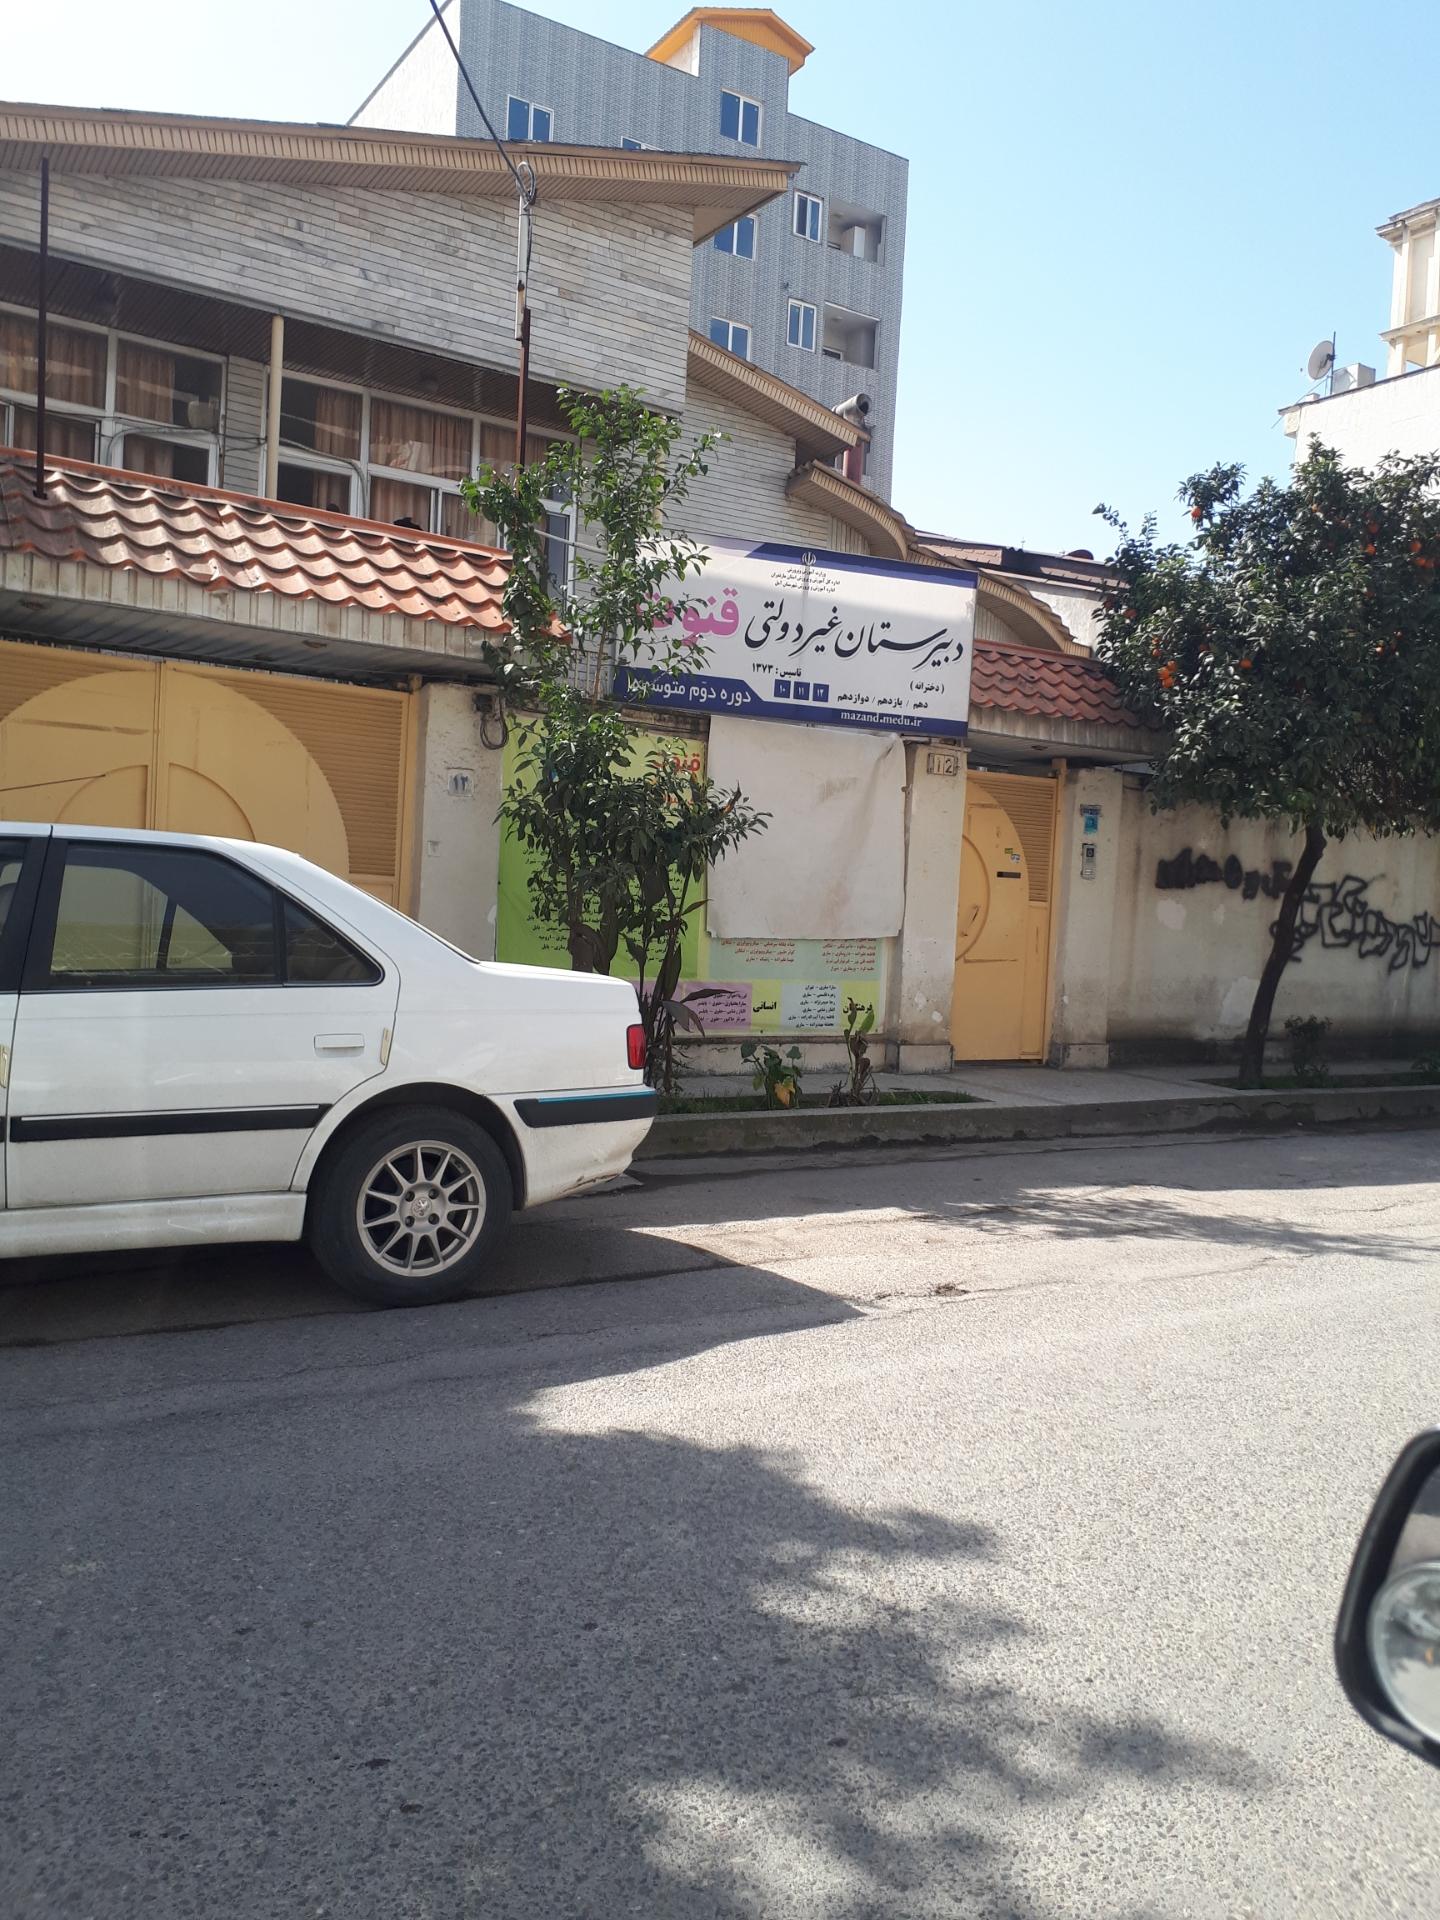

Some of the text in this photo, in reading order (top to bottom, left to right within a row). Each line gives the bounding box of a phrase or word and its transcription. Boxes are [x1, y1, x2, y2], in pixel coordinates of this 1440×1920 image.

[834, 611, 964, 670] دبیرستان
[720, 688, 752, 706] دوره
[837, 692, 870, 705] دوازدهم
[913, 701, 928, 710] دهم
[840, 710, 922, 727] mazand.medu.ir
[752, 1000, 777, 1013] انسانی
